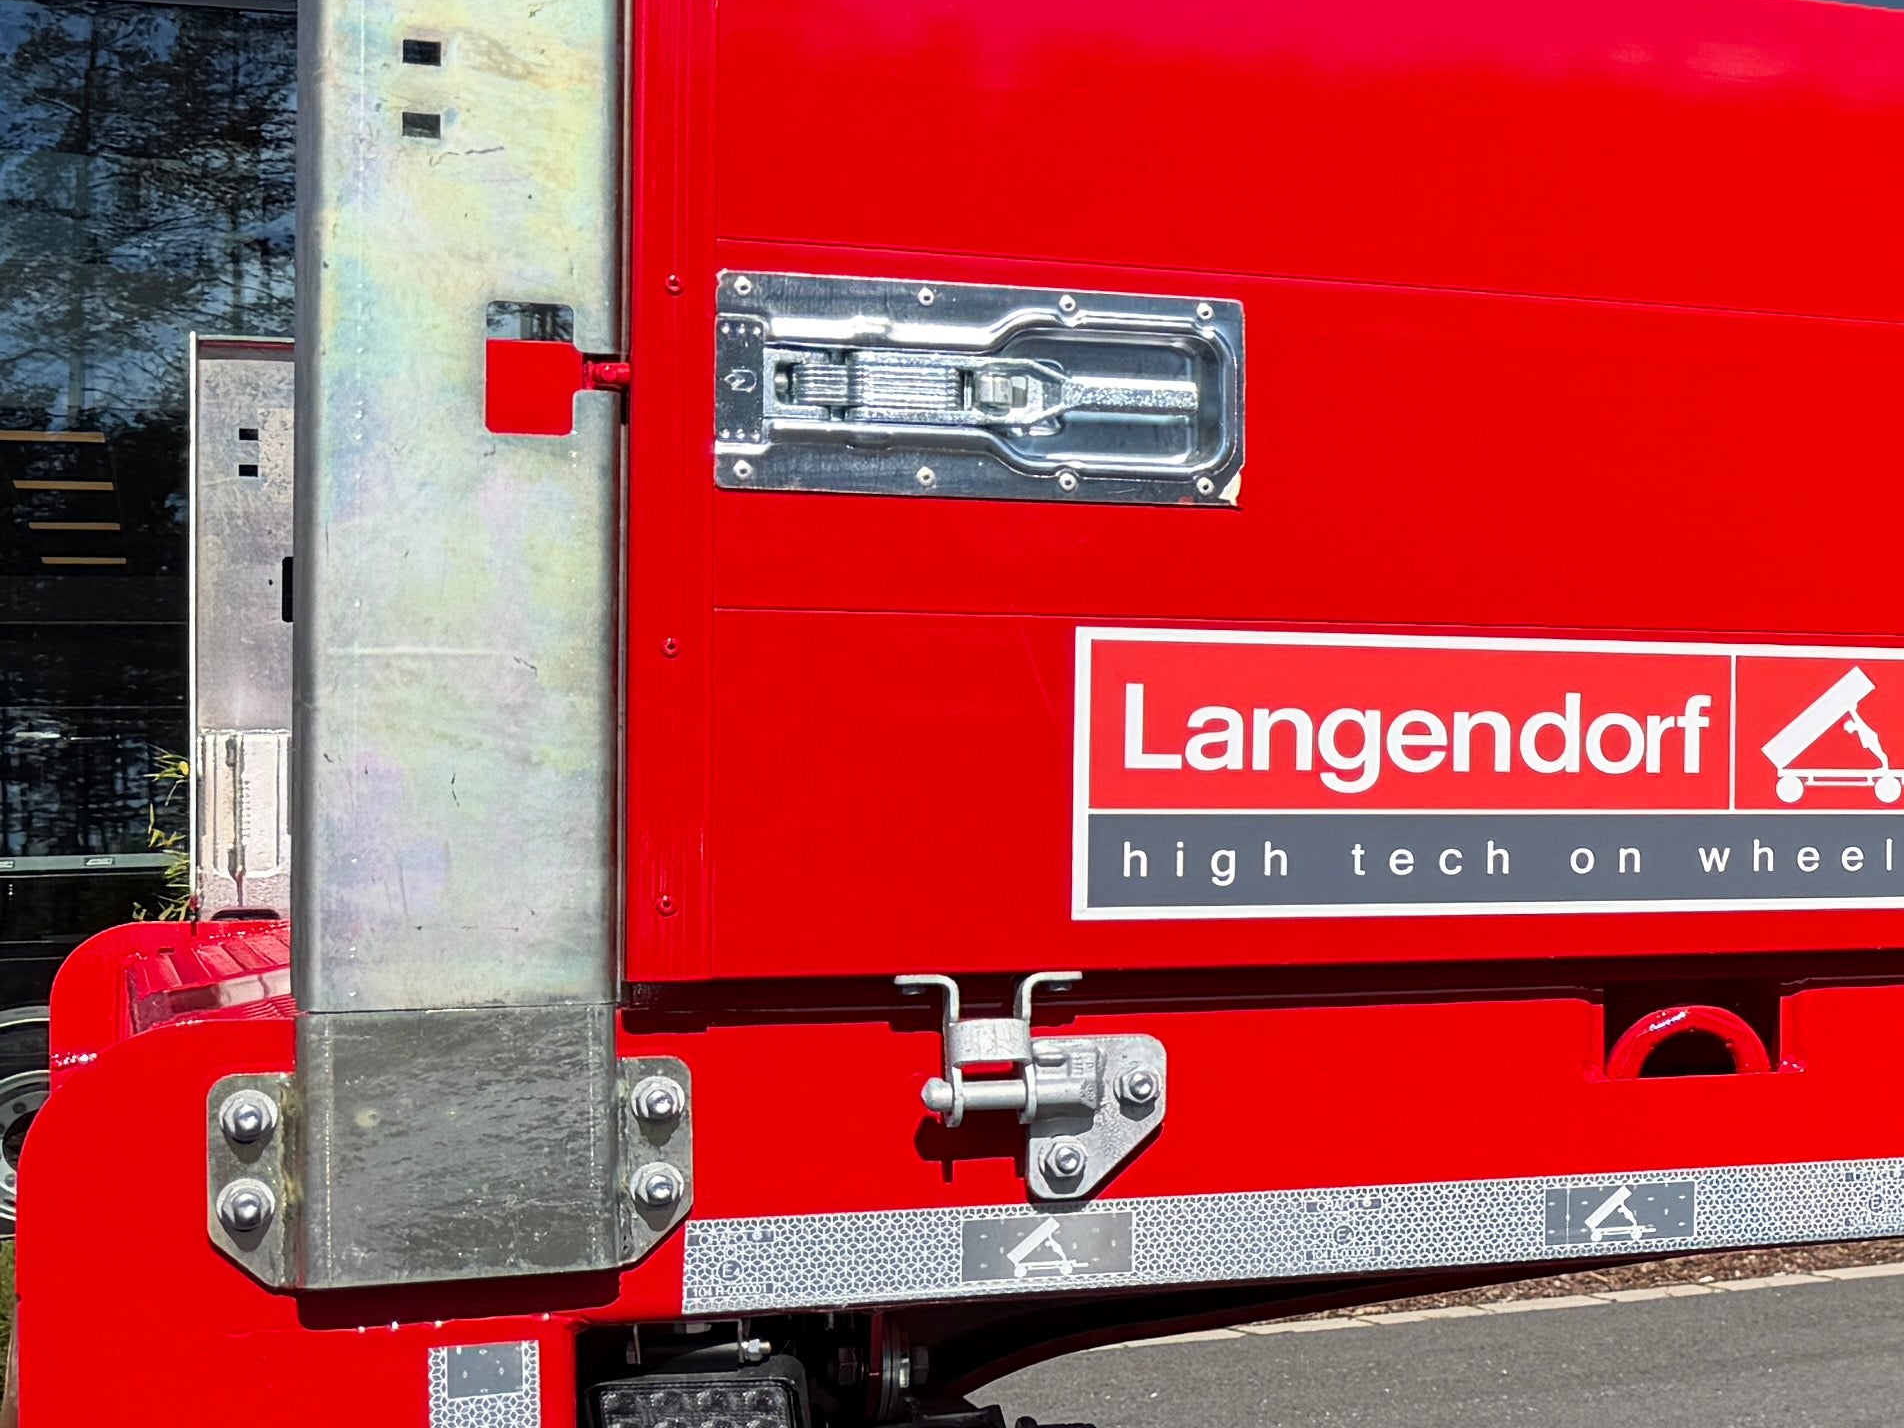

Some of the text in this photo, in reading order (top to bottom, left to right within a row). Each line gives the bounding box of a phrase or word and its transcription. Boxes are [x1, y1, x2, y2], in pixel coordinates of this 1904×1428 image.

[1123, 682, 1713, 794] Langendorf
[1123, 841, 1290, 887] high
[1351, 841, 1512, 876] tech
[1569, 840, 1643, 875] on
